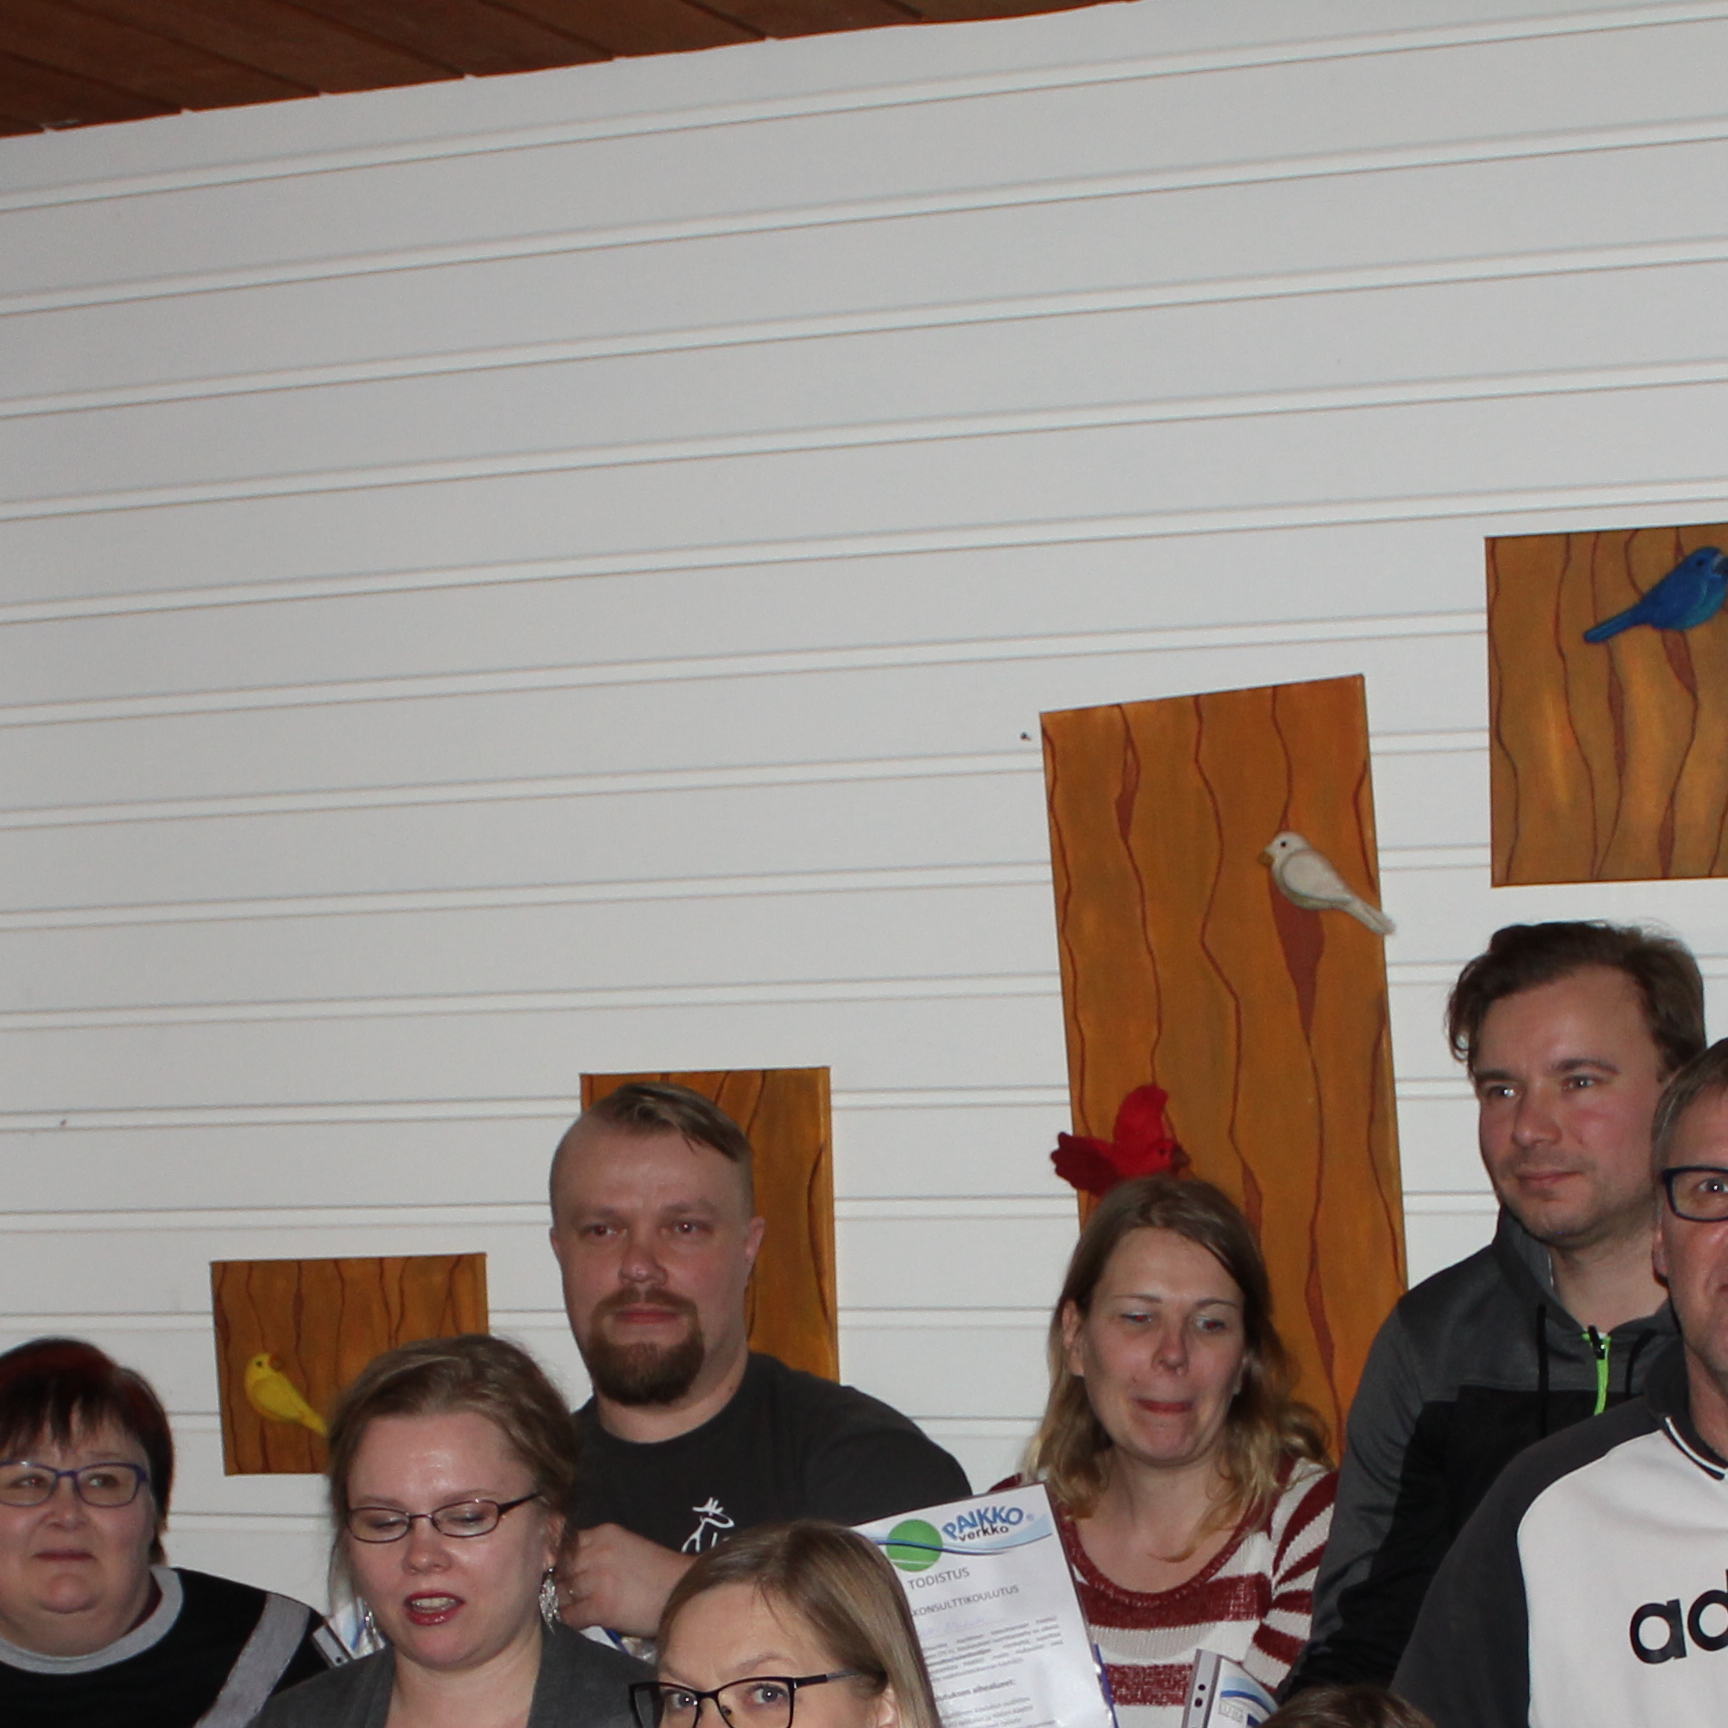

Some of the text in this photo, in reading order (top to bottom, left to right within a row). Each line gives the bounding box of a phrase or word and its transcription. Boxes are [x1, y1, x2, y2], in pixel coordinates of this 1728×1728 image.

[941, 1505, 1024, 1540] PAIKKO
[959, 1518, 1009, 1542] verkko
[908, 1566, 970, 1591] TODISTUS
[912, 1585, 1020, 1616] KONSULTTIKOULUTUS
